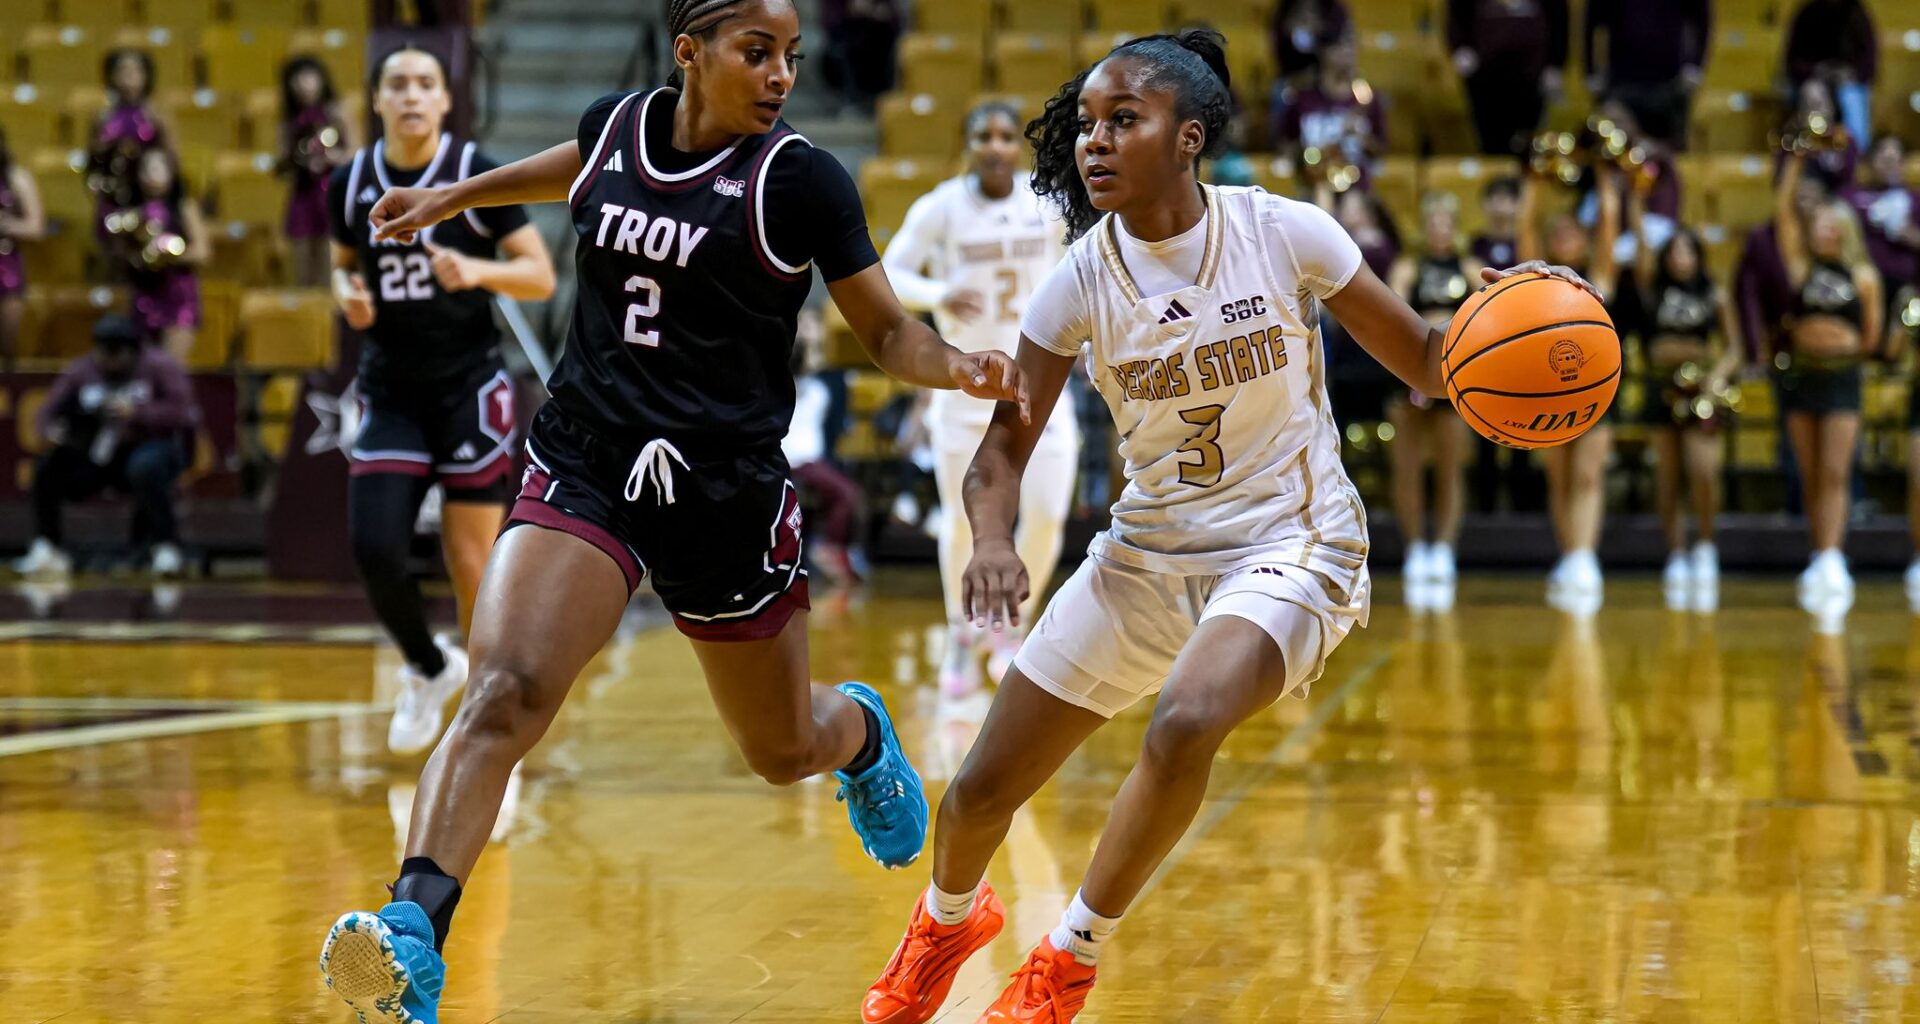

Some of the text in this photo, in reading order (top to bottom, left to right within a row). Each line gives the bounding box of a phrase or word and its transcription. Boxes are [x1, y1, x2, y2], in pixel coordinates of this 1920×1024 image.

[595, 203, 709, 268] TROY
[378, 253, 434, 300] 22
[995, 268, 1019, 321] 2
[624, 275, 661, 347] 2
[1220, 295, 1267, 324] SBC
[1194, 324, 1289, 391] STATE
[1176, 403, 1226, 488] 3
[1527, 402, 1599, 432] EVO
